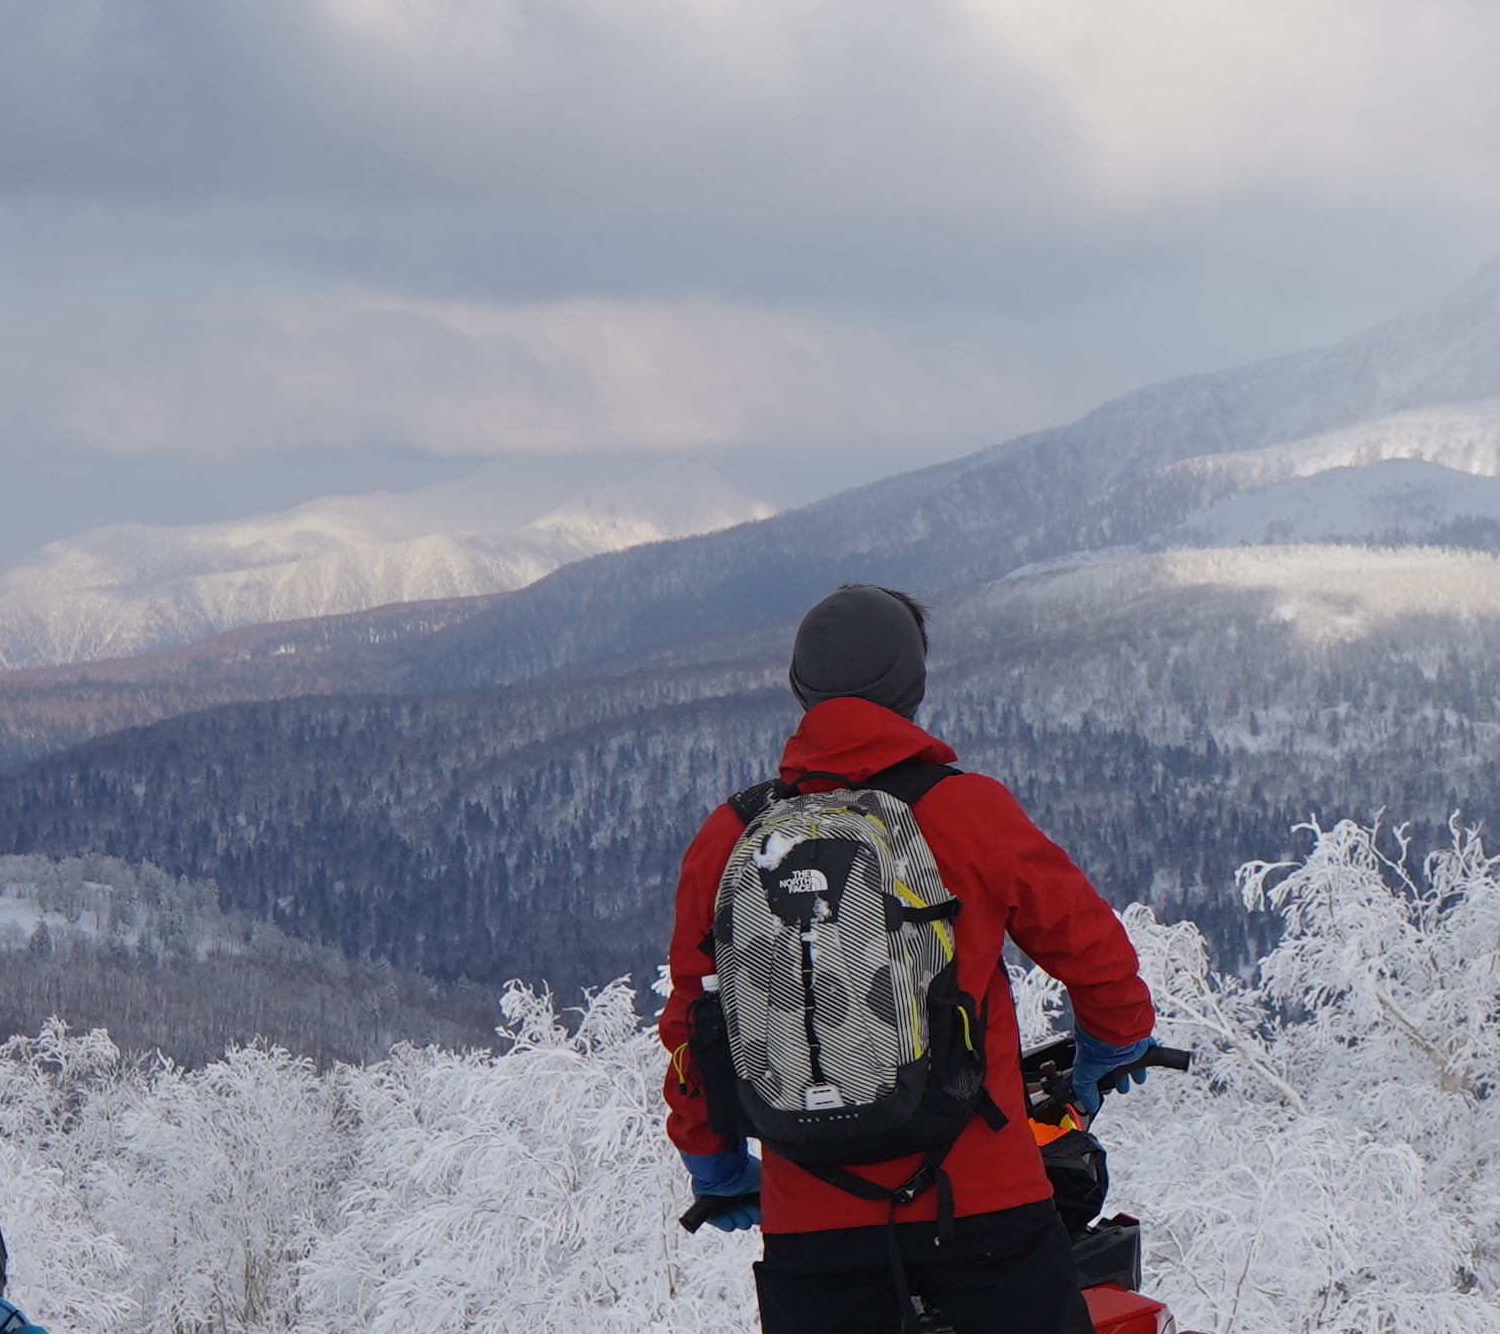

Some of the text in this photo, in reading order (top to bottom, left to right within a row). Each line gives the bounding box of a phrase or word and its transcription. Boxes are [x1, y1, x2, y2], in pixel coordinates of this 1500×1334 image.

[792, 869, 811, 879] THE
[779, 877, 812, 889] NORTH
[788, 885, 812, 894] FACE
